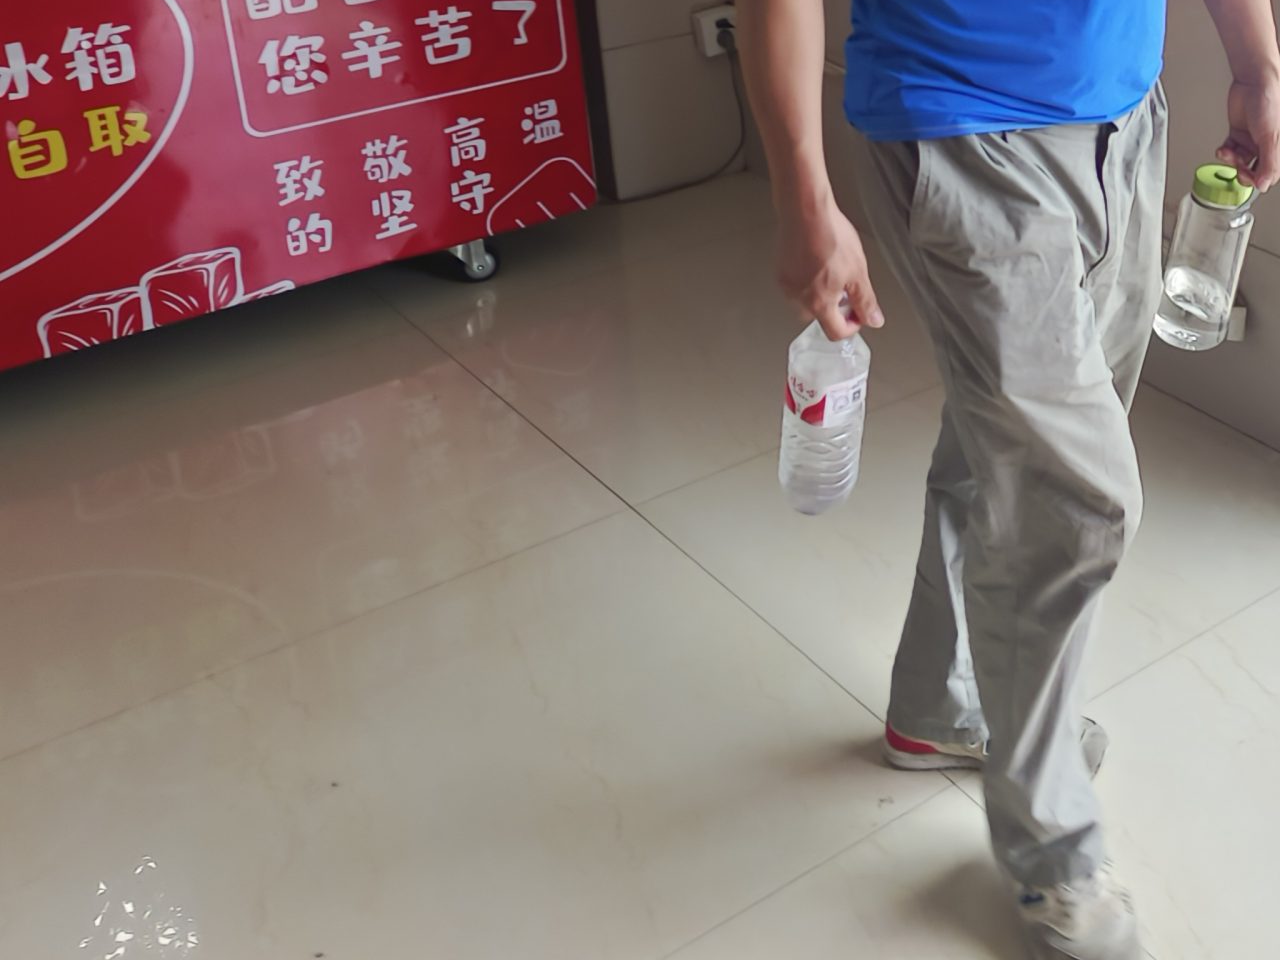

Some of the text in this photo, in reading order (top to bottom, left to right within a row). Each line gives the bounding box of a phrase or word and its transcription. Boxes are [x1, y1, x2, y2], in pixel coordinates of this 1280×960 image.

[258, 0, 536, 96] 您辛苦了
[8, 106, 151, 179] 自取
[273, 98, 564, 206] 致敬高温
[286, 170, 494, 257] 的坚守
